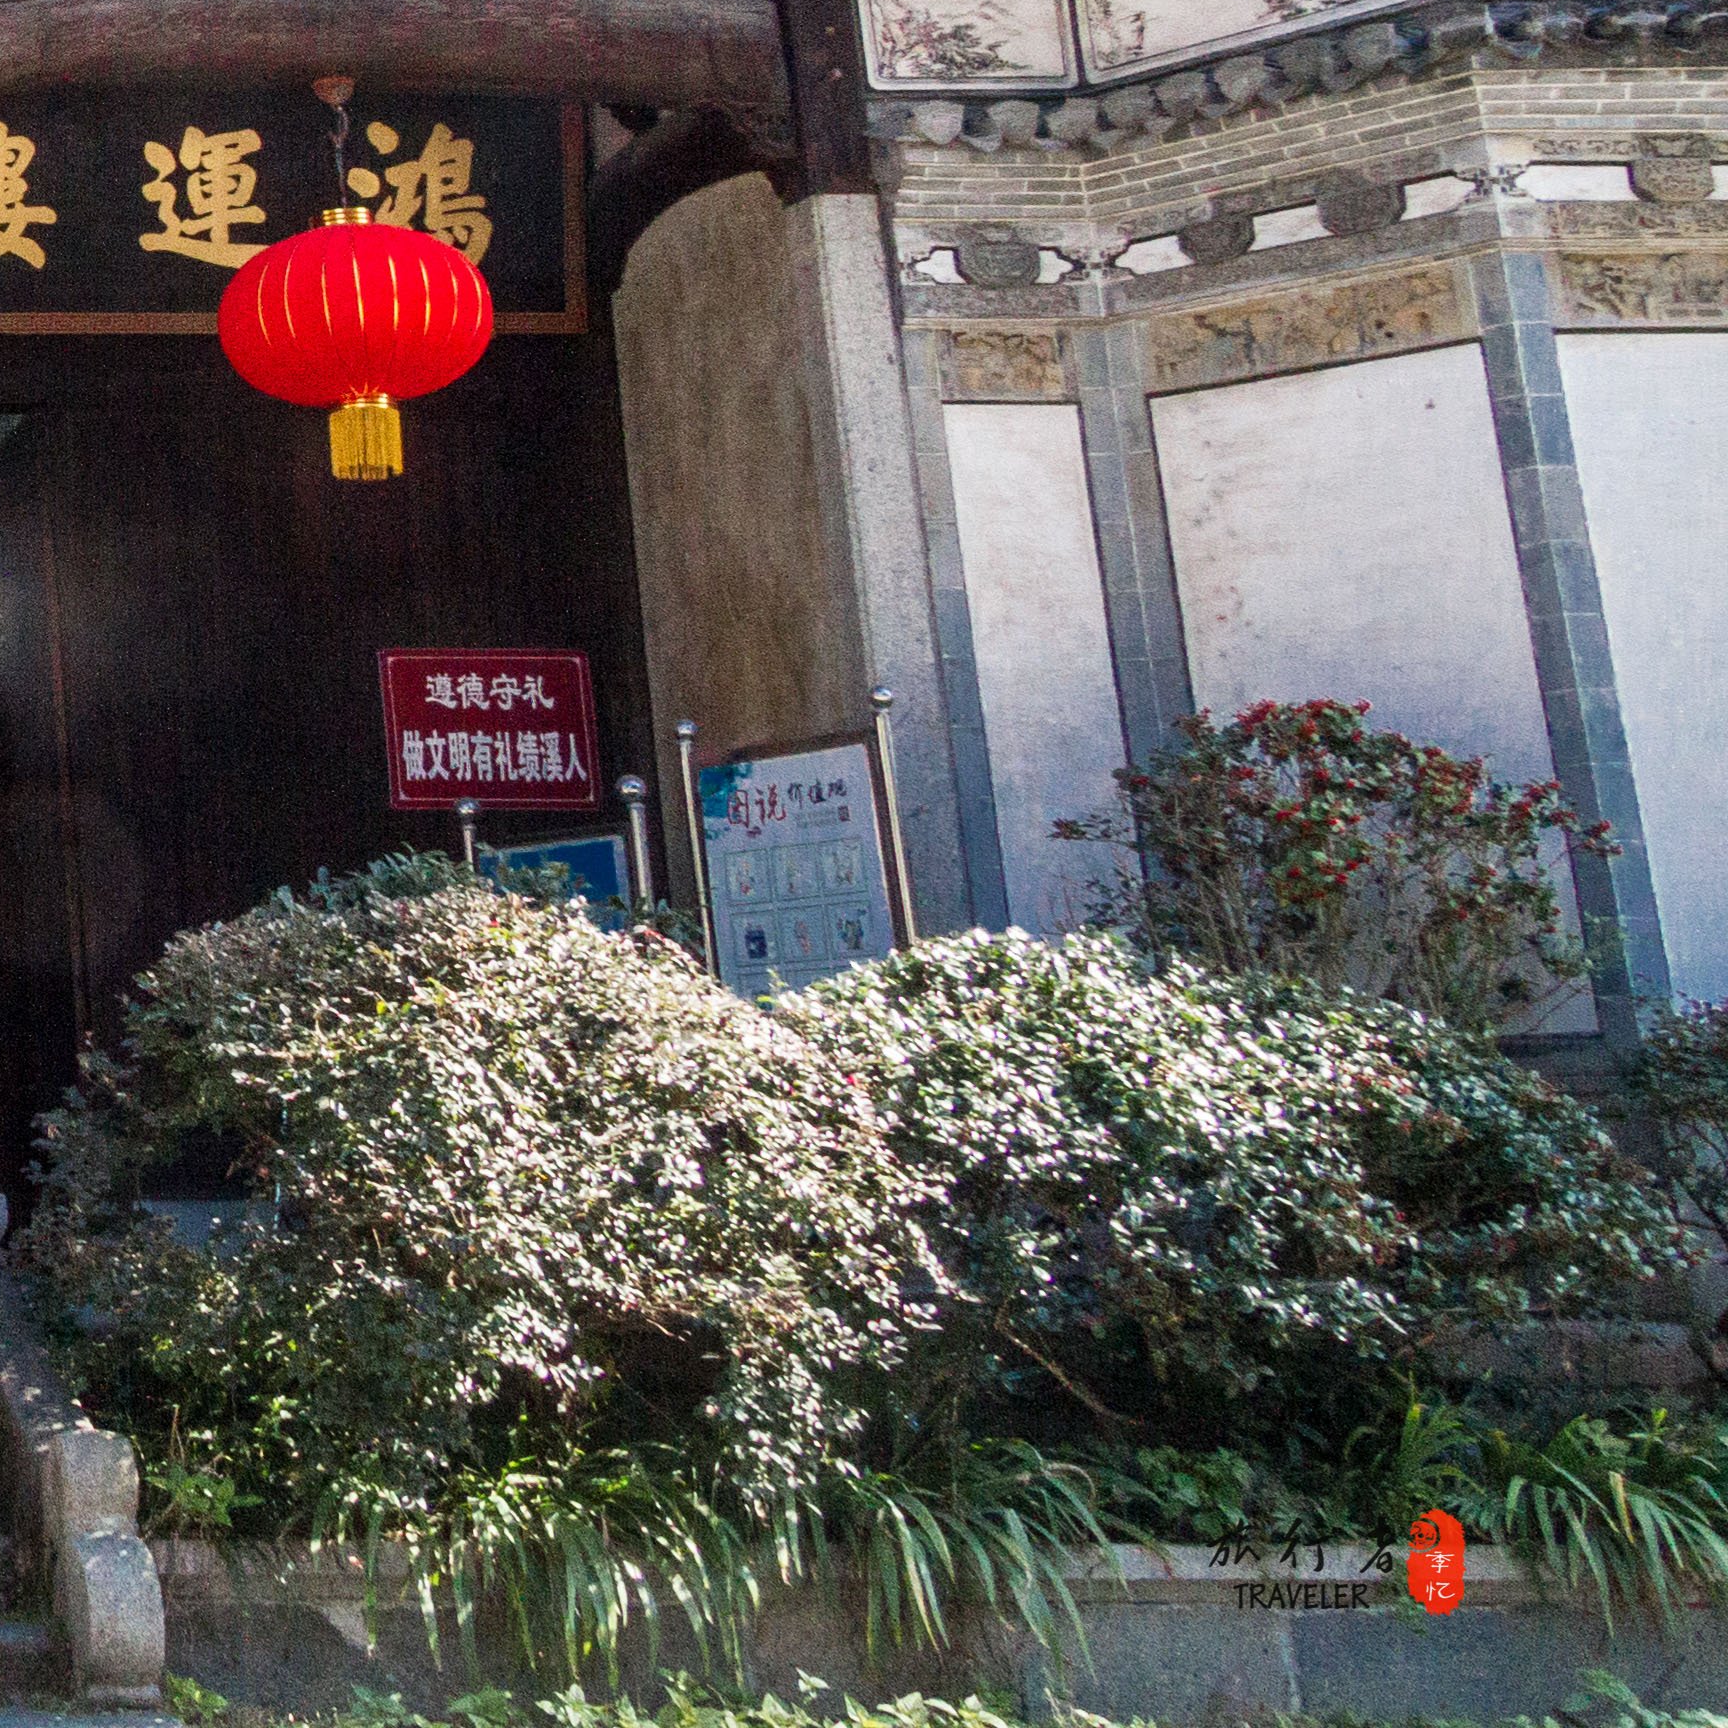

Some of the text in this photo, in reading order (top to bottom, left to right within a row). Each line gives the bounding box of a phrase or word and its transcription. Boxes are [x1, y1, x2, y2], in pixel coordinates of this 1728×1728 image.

[425, 673, 555, 710] 遵德守礼
[402, 729, 587, 782] 做文明有礼绩溪人
